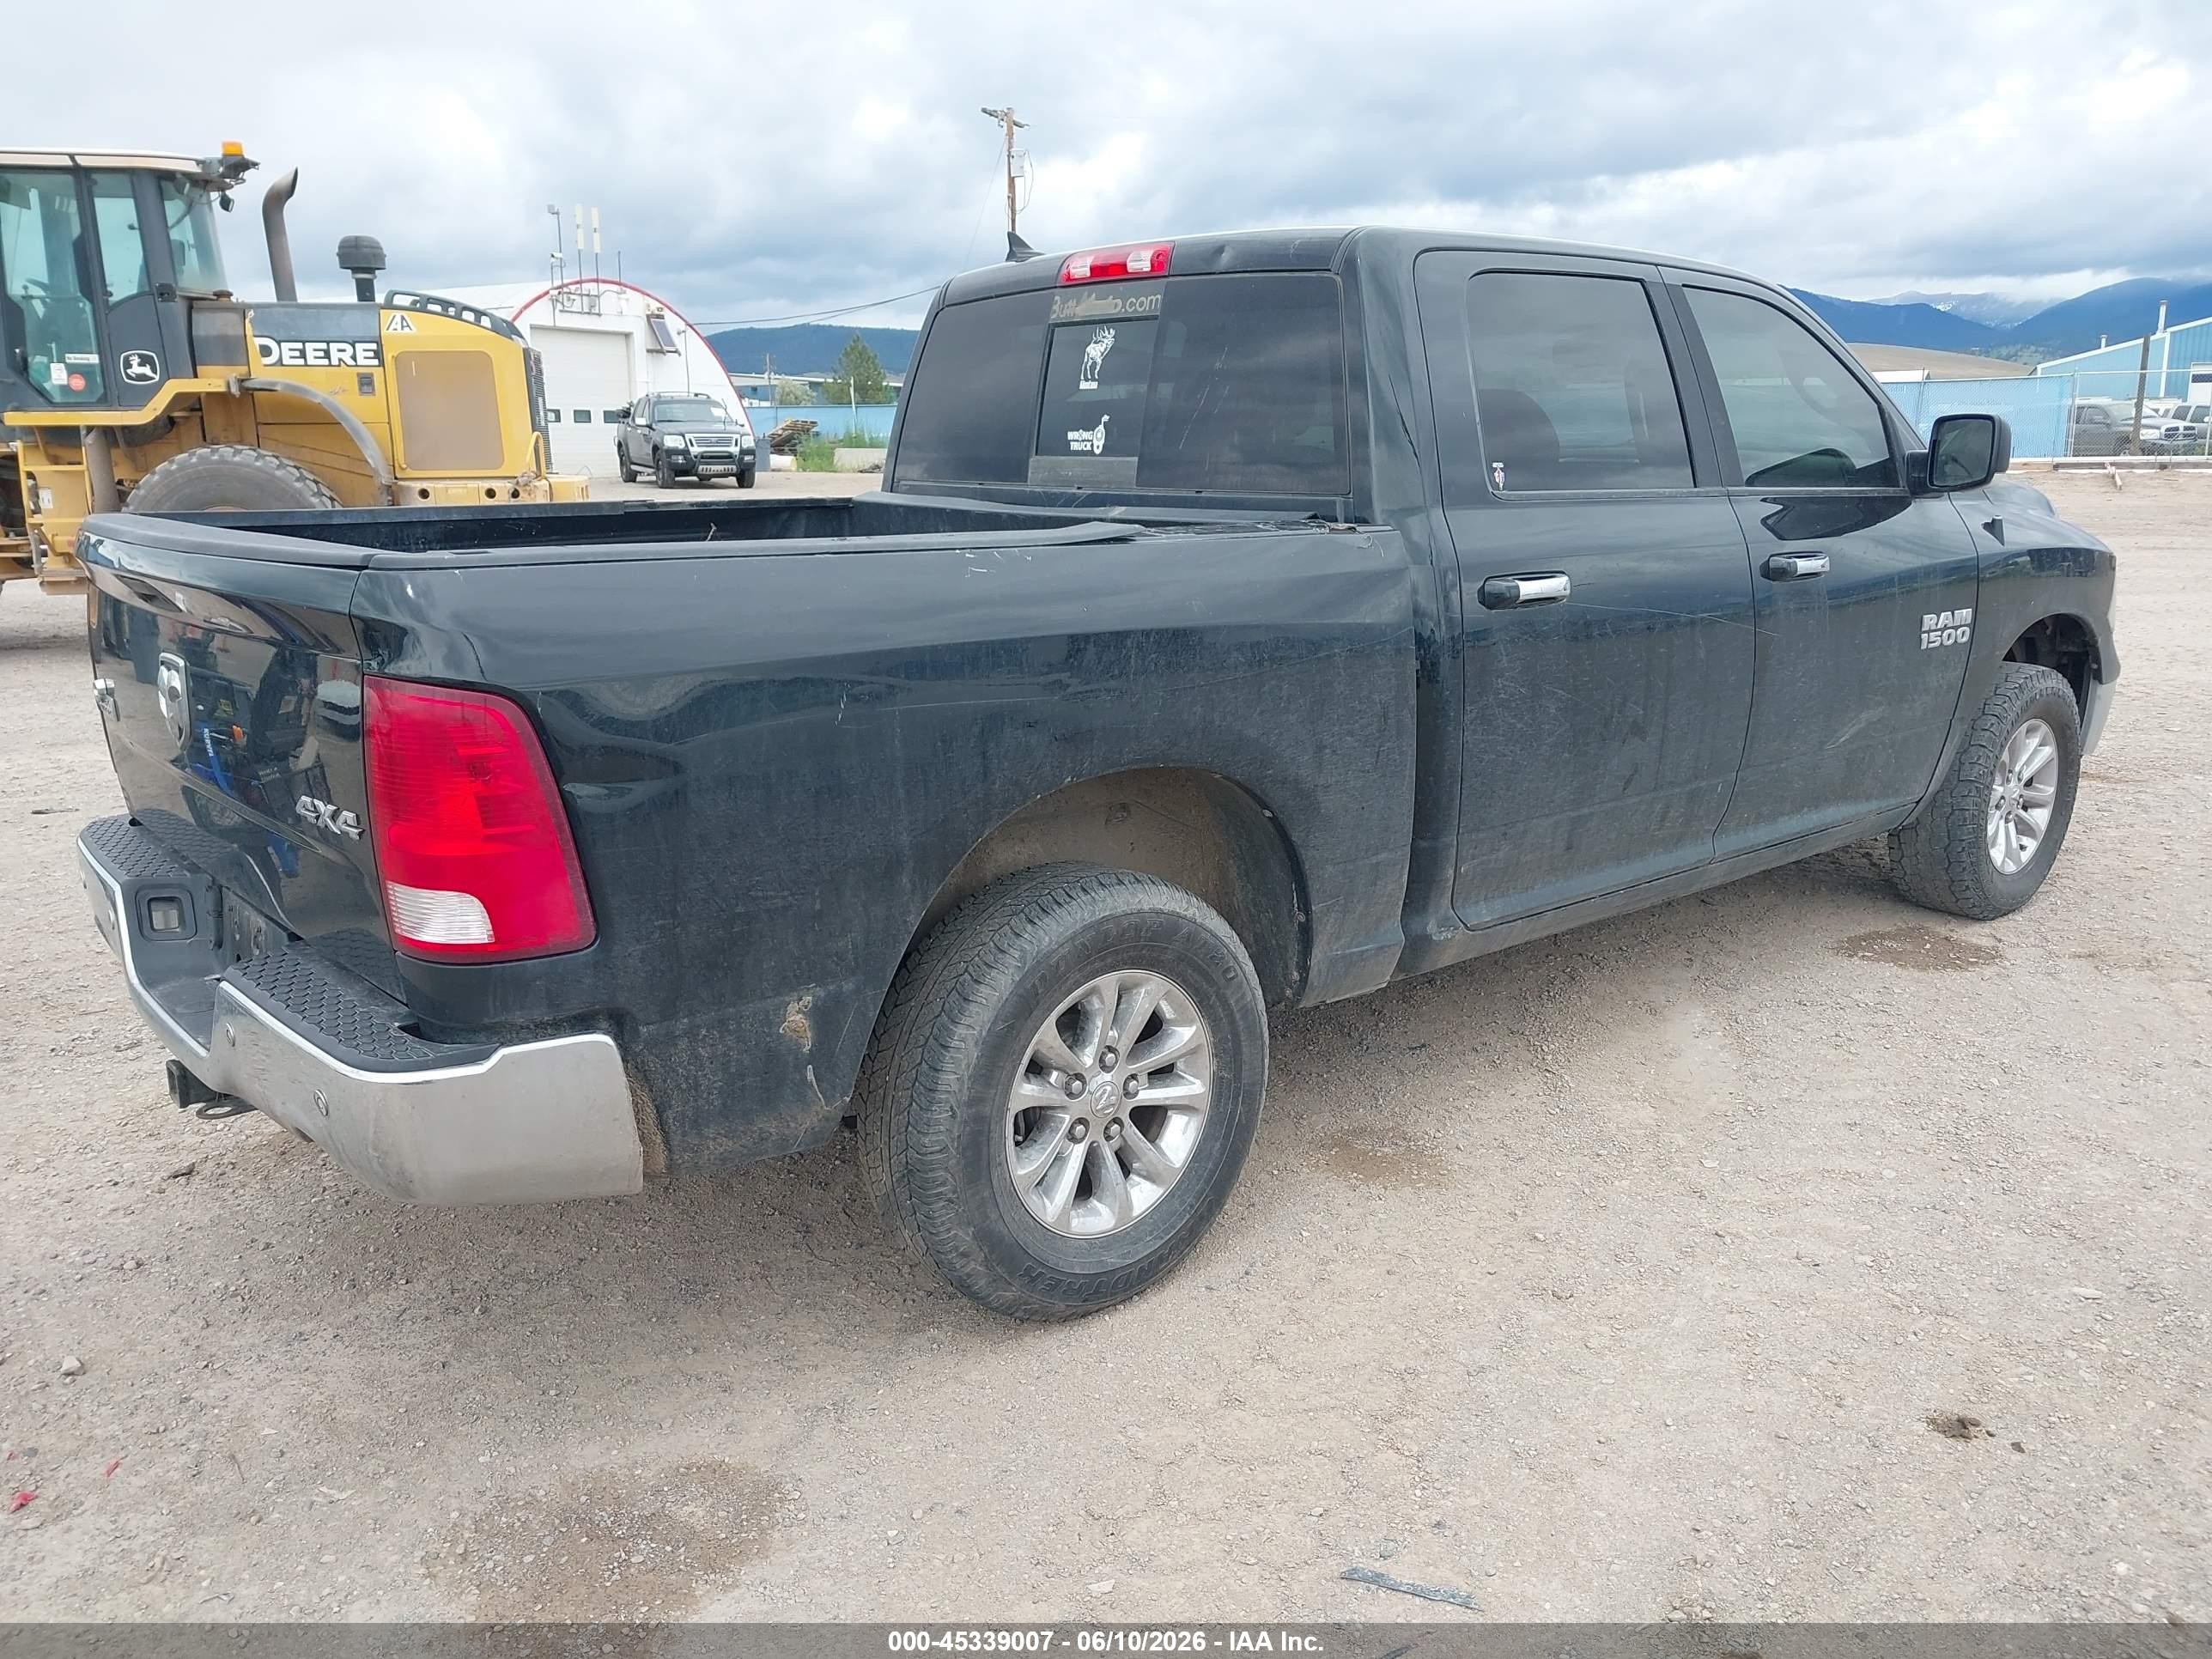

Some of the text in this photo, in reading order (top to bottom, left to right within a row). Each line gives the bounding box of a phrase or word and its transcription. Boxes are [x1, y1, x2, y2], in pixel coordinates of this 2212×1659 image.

[253, 337, 380, 367] DEERE
[1070, 441, 1092, 451] TRUCK
[1922, 608, 1972, 632] RAM
[1920, 626, 1971, 650] 1500
